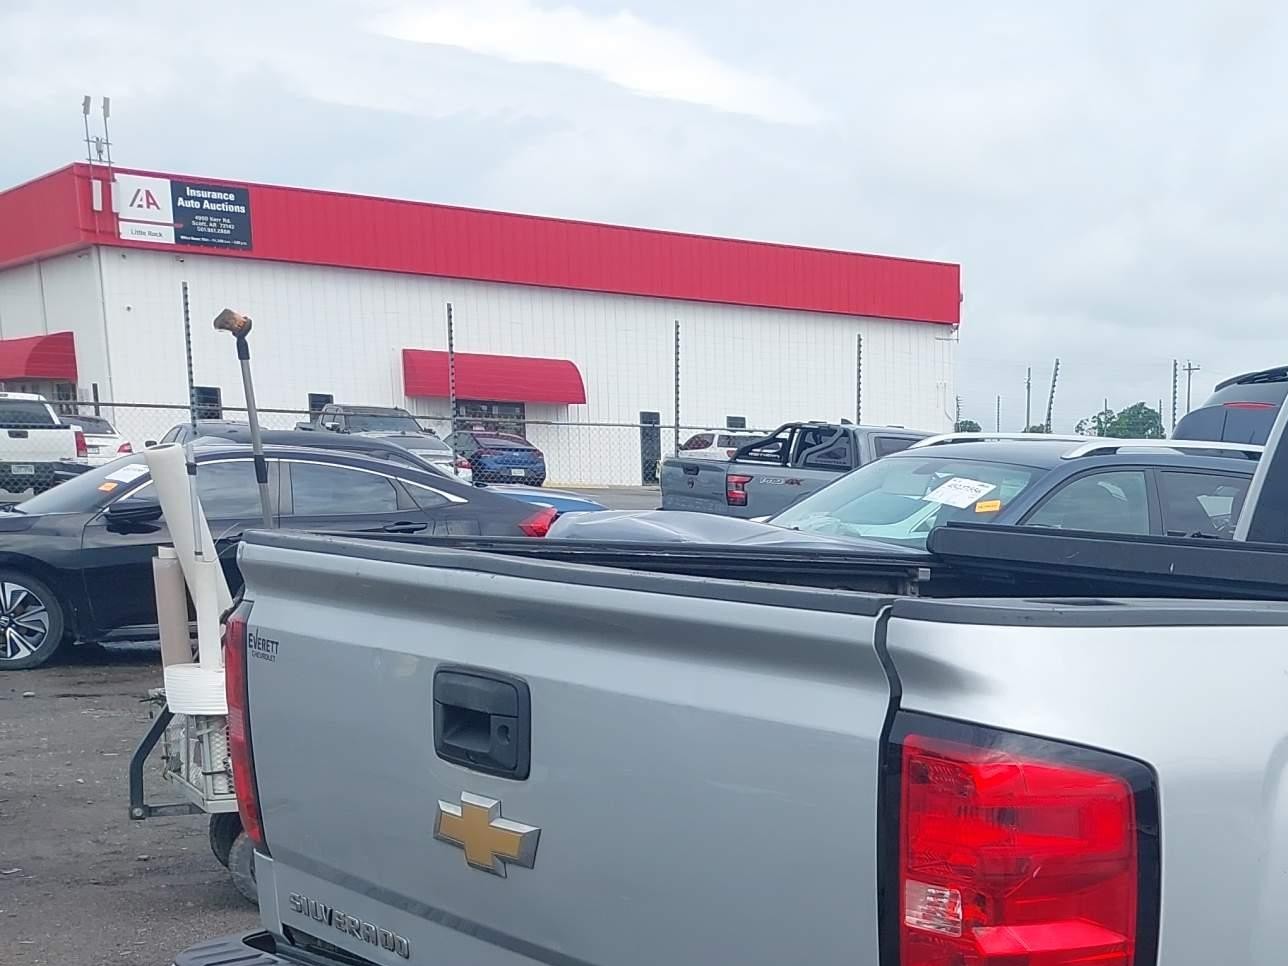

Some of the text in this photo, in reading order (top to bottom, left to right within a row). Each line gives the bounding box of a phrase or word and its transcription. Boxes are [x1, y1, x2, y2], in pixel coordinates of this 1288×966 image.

[186, 186, 235, 200] Insurance
[177, 197, 246, 213] Auto Auctions
[248, 626, 280, 655] EVERETT
[288, 892, 411, 960] SILVERADO
